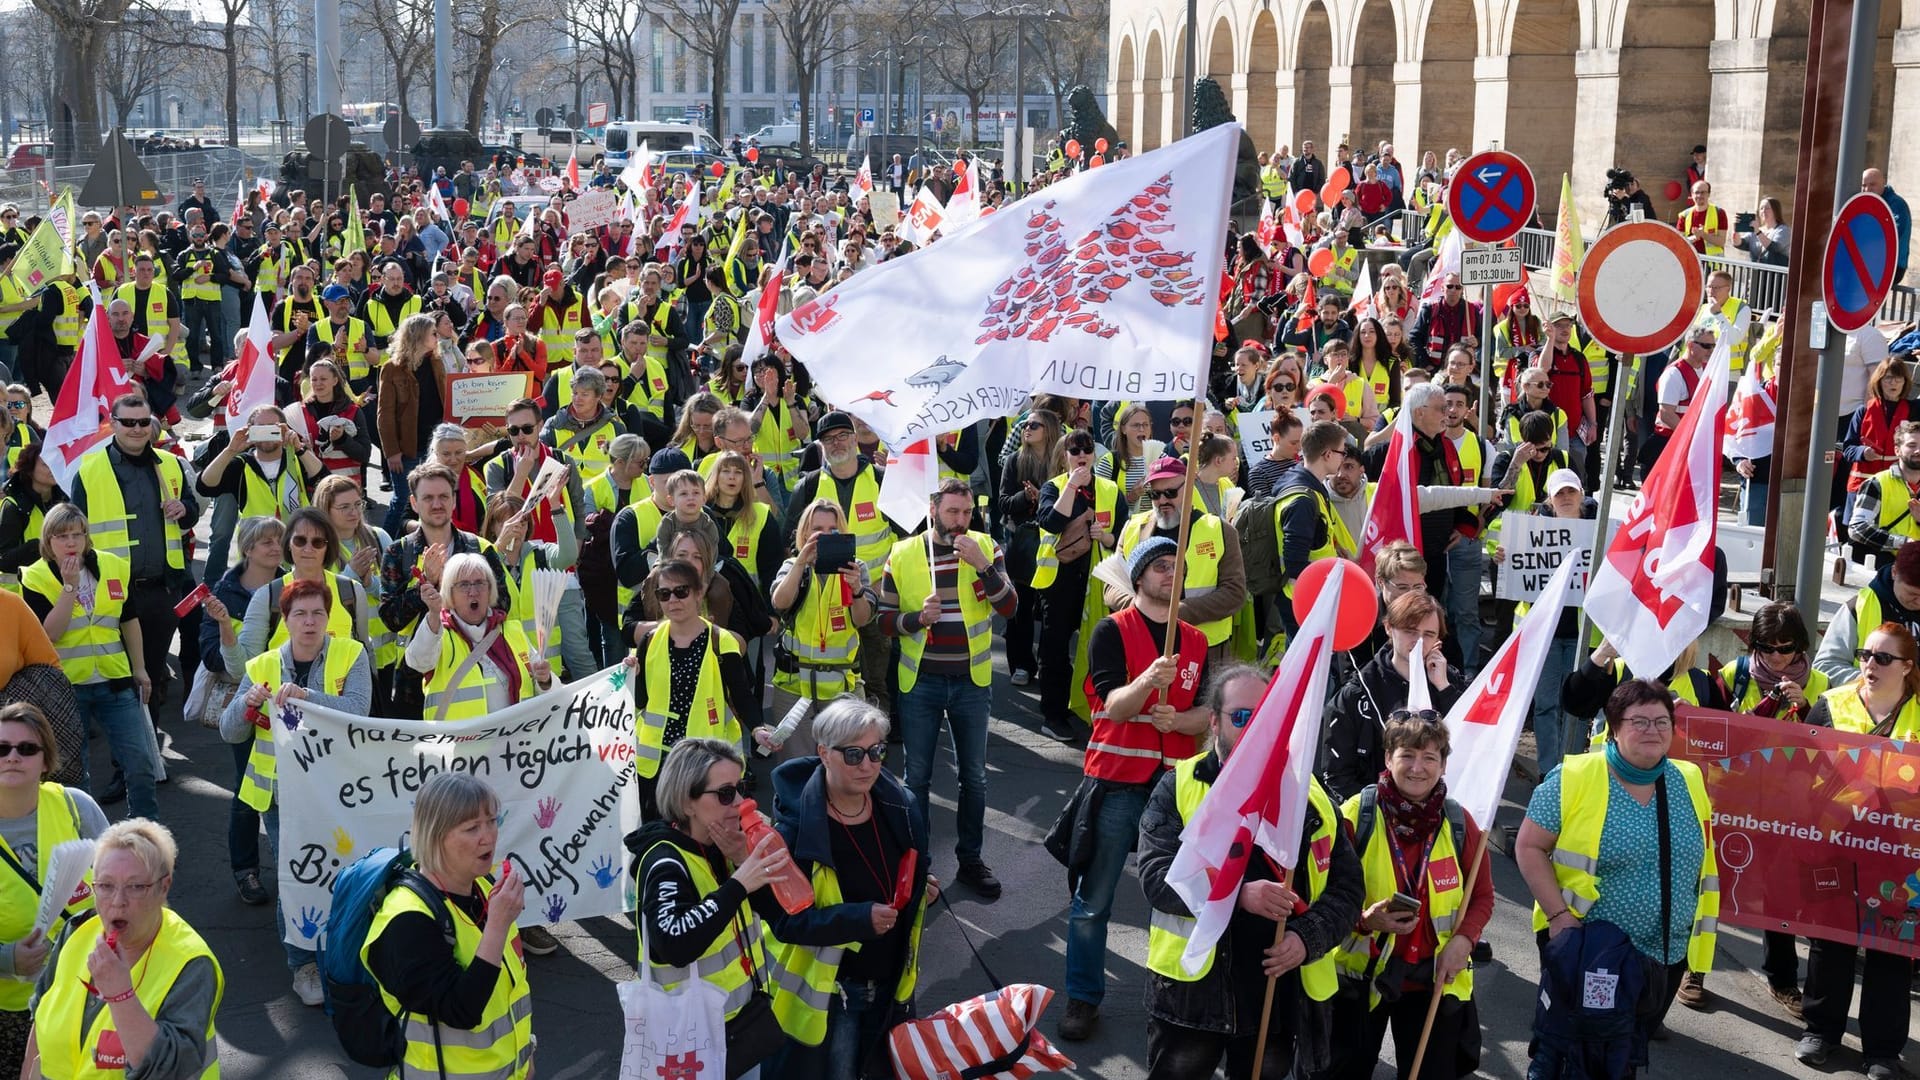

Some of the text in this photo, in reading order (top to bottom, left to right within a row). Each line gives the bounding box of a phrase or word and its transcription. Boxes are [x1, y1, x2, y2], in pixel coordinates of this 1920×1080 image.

[864, 109, 872, 120] P
[1466, 255, 1478, 265] am
[1509, 251, 1519, 262] 25
[1501, 269, 1515, 280] Uhr
[471, 380, 485, 388] bin
[1530, 529, 1571, 548] WIR
[1511, 552, 1562, 570] SIND
[293, 728, 334, 773] Wir
[348, 723, 456, 750] haben
[455, 733, 482, 744] nur
[480, 704, 560, 738] zwei
[1690, 738, 1724, 751] ver.di
[339, 776, 373, 808] es
[500, 734, 592, 790] täglich
[599, 736, 636, 762] vier
[1435, 876, 1458, 887] ver.di
